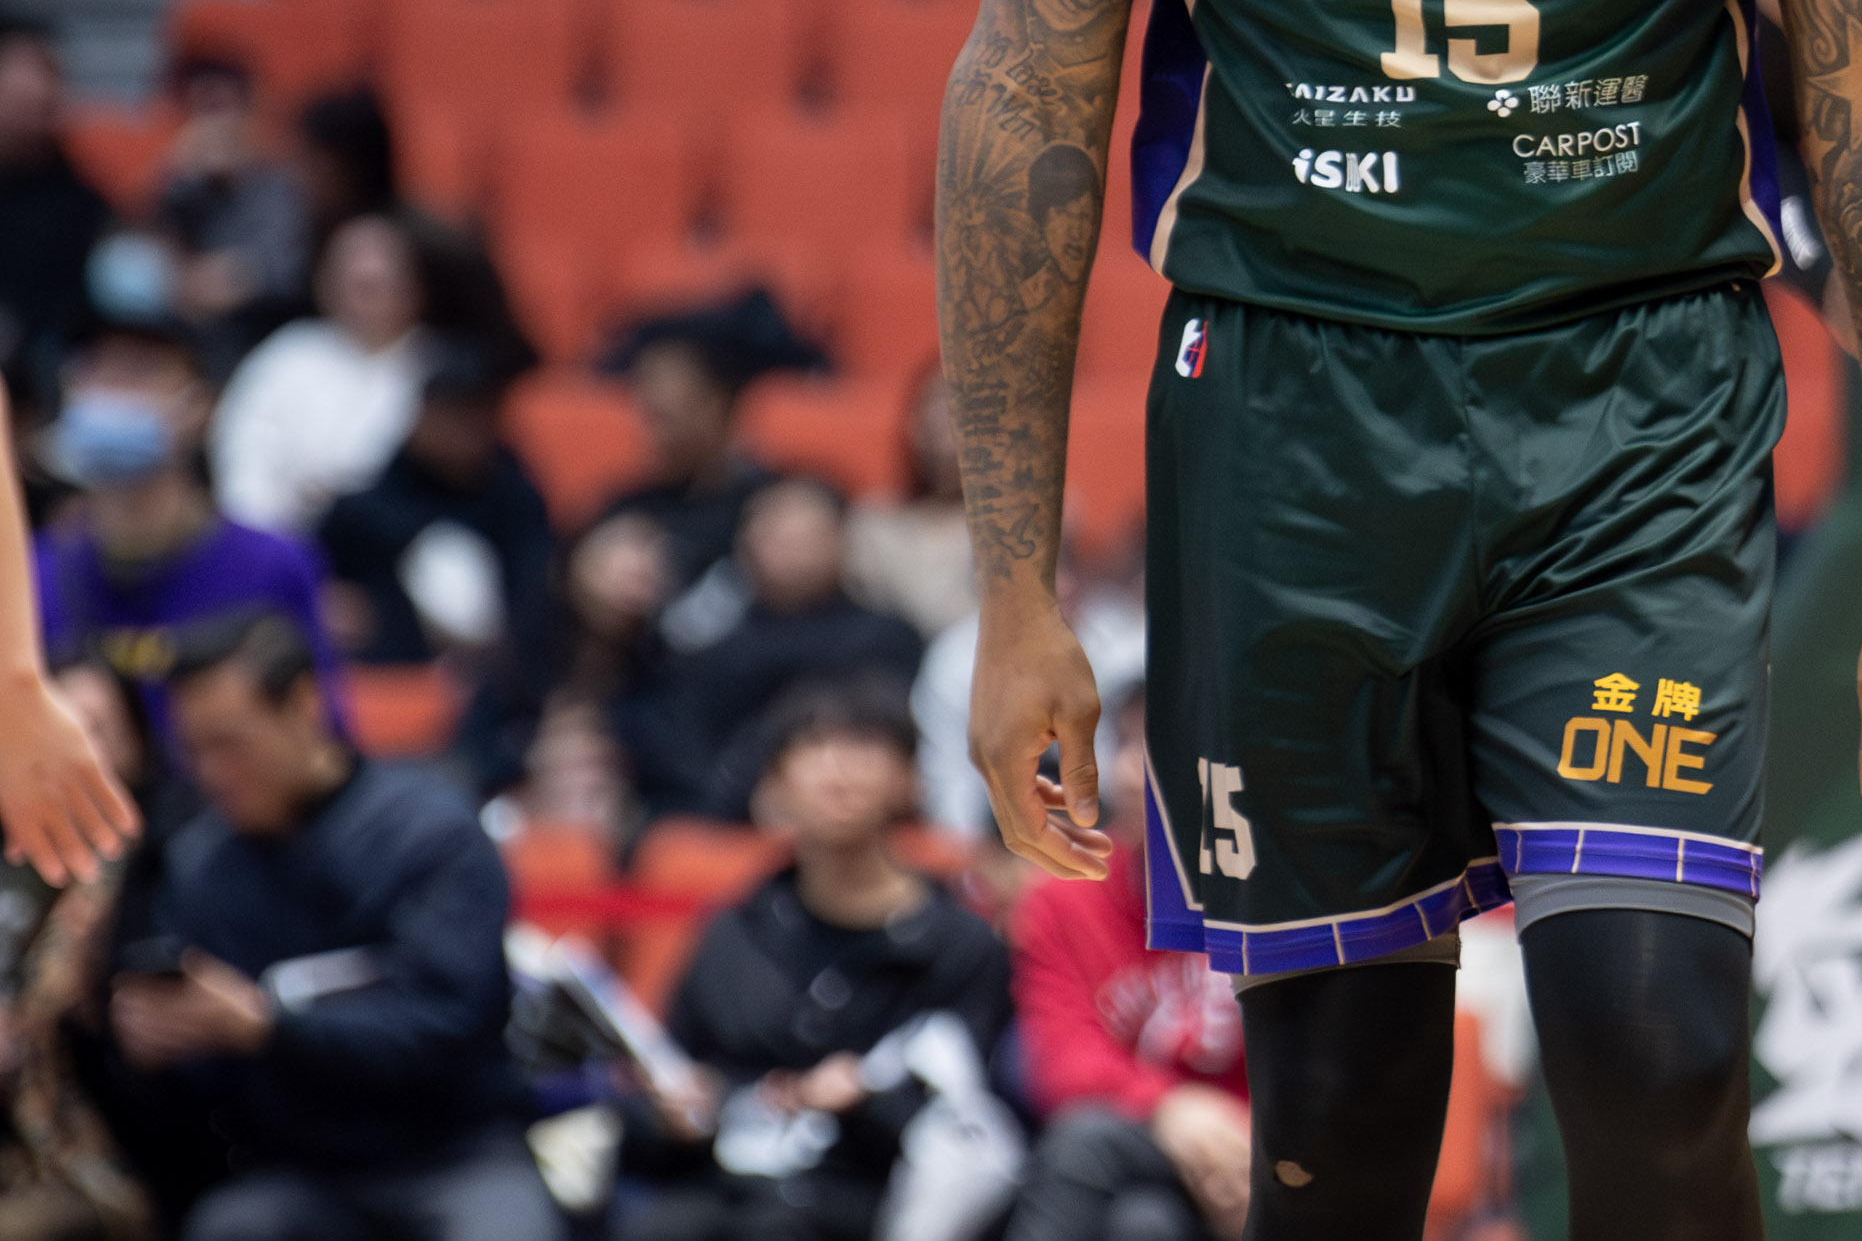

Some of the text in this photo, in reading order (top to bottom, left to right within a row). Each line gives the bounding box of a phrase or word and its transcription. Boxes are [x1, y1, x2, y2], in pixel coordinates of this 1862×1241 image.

[1284, 83, 1417, 103] AIZAKU
[1528, 74, 1648, 114] 聯新運醫
[1291, 108, 1401, 128] 火星生技
[1512, 121, 1641, 158] CARPOST
[1292, 149, 1400, 193] iSKI
[1523, 150, 1638, 185] 豪華車訂閱
[1592, 672, 1702, 722] 金牌
[1557, 716, 1718, 795] ONE
